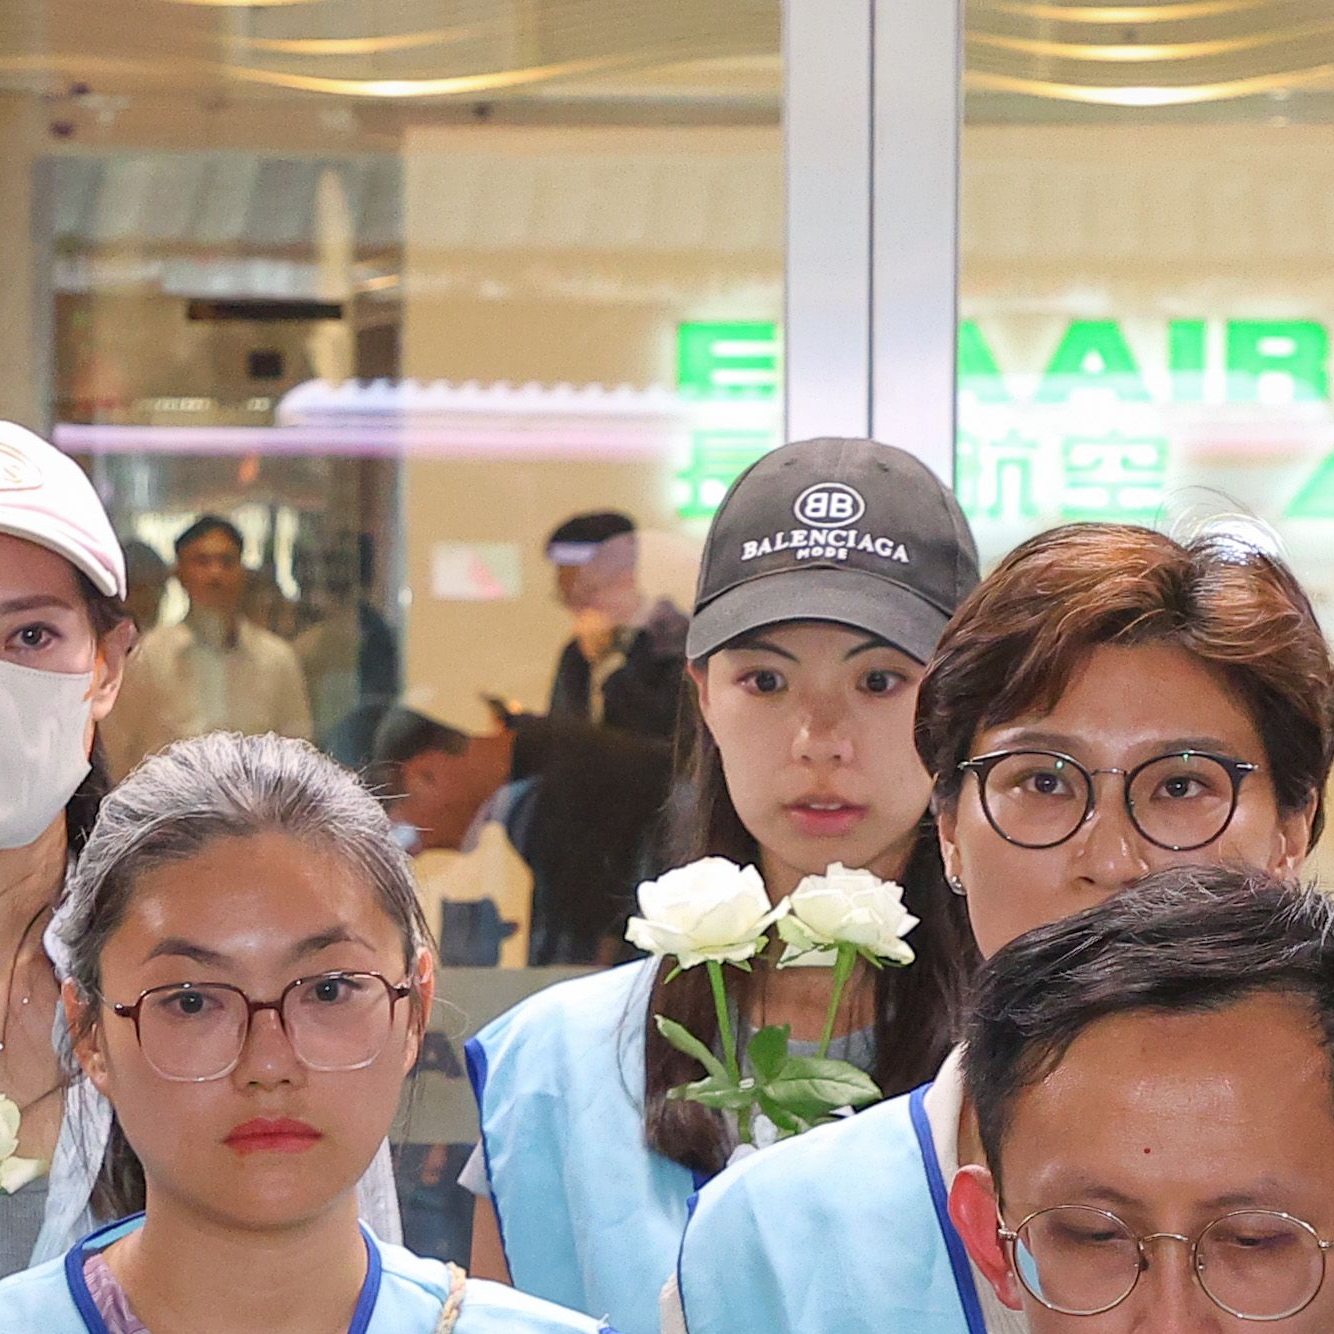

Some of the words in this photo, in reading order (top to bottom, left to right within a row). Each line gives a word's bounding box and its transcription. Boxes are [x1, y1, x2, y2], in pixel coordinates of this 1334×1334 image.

[1047, 320, 1332, 402] AIR
[741, 529, 910, 563] BALENCIAGA
[796, 547, 849, 560] MODE
